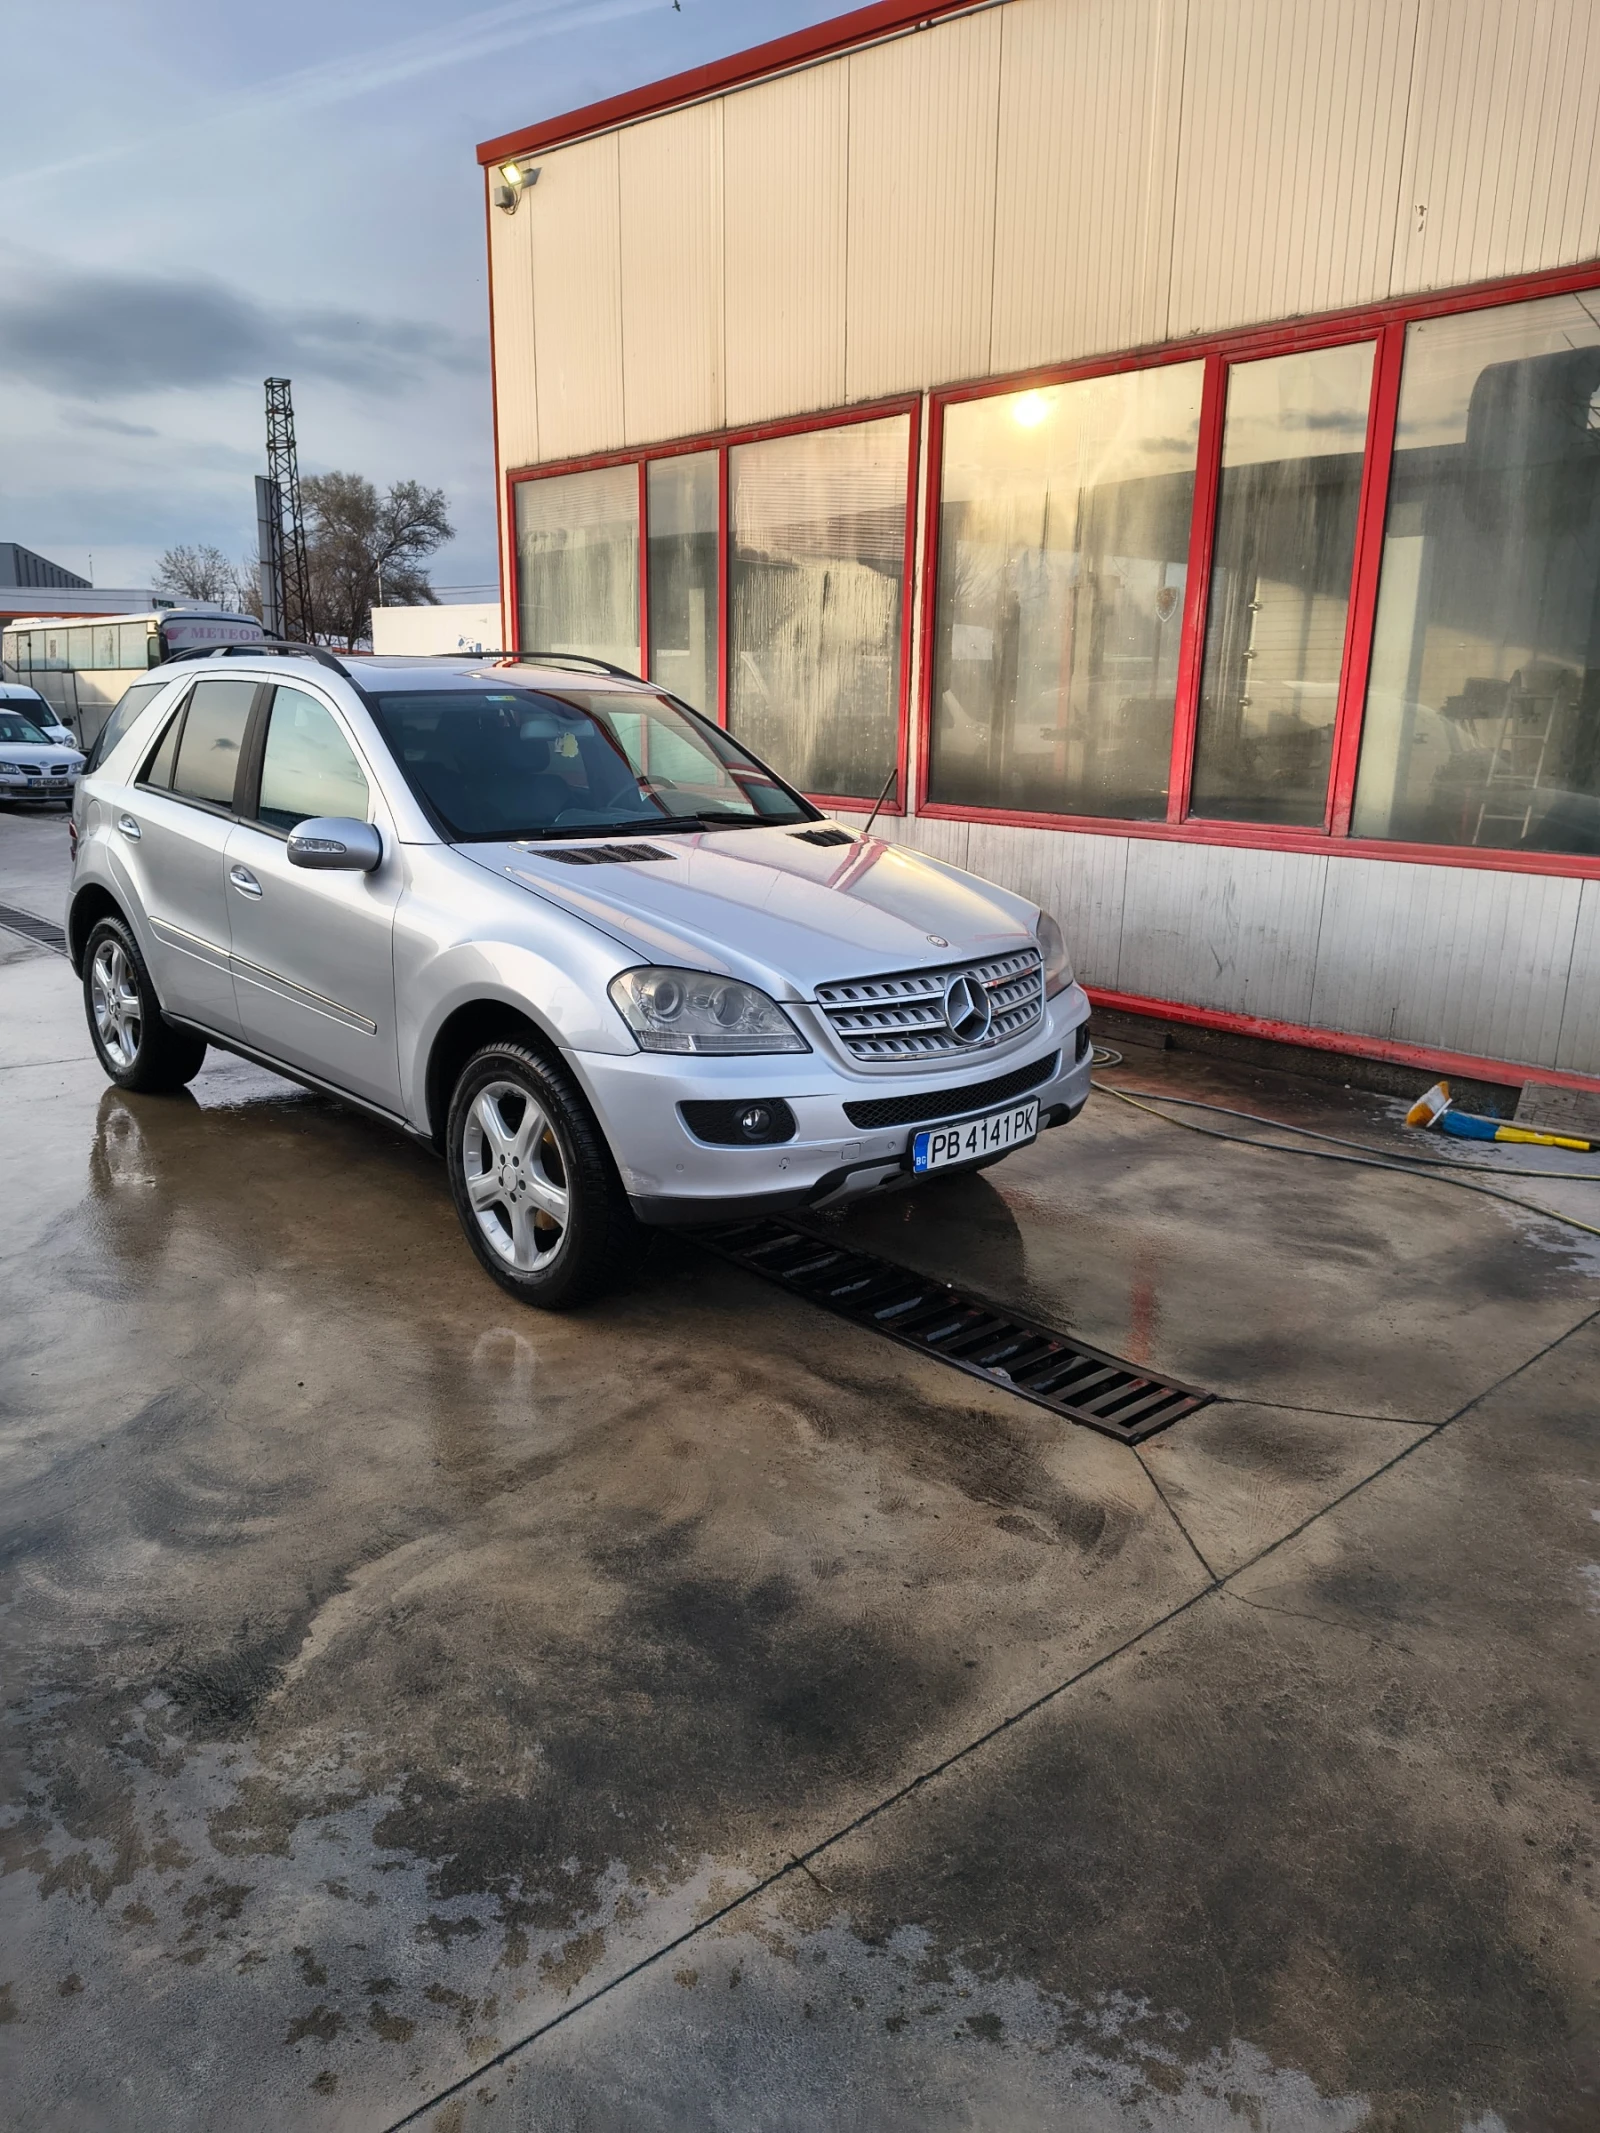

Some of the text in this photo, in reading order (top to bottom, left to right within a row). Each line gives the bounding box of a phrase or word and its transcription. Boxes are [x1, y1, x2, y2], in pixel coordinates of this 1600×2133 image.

[931, 1106, 1035, 1163] PB 4141 PK
[916, 1156, 927, 1166] BG
